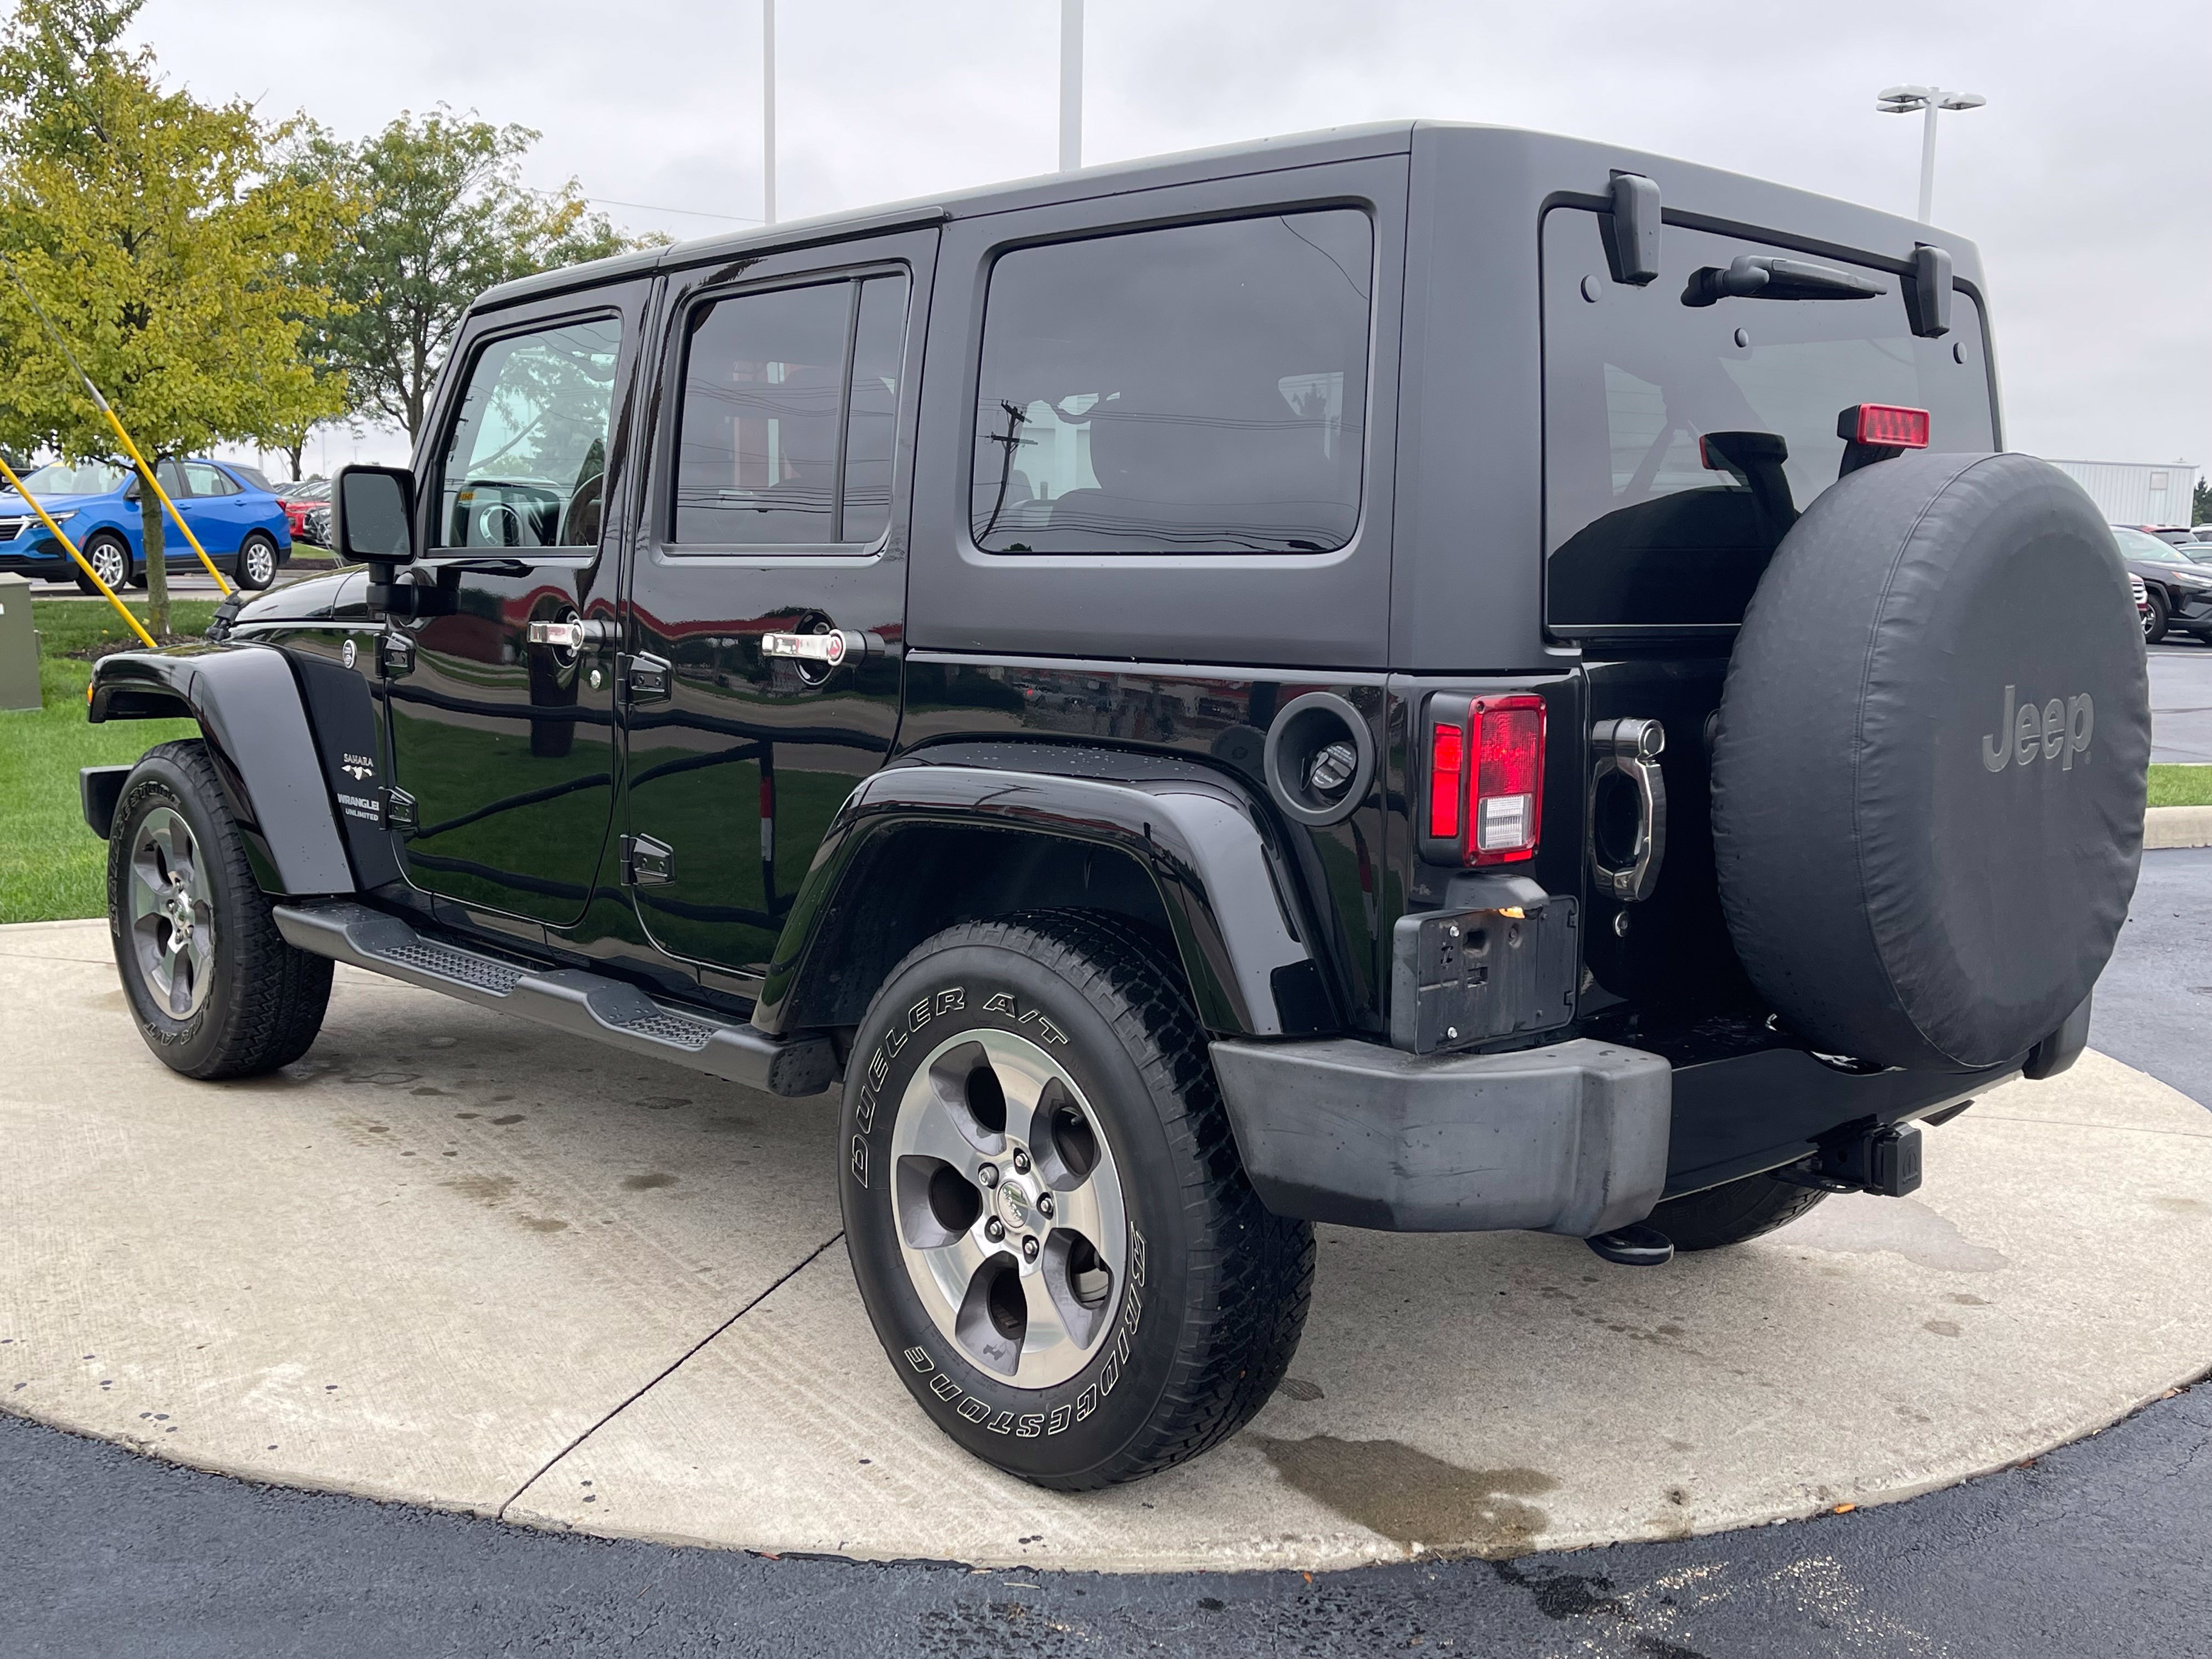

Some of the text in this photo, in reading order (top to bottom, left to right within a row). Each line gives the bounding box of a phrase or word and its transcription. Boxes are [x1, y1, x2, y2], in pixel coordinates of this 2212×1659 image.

[1982, 684, 2094, 772] Jeep
[343, 753, 374, 768] SAHARA
[337, 793, 380, 811] WRANGLE
[345, 808, 379, 822] UNLIMITED
[851, 986, 1071, 1189] DUELER A/T
[904, 1221, 1147, 1437] BRIDGESTONE
